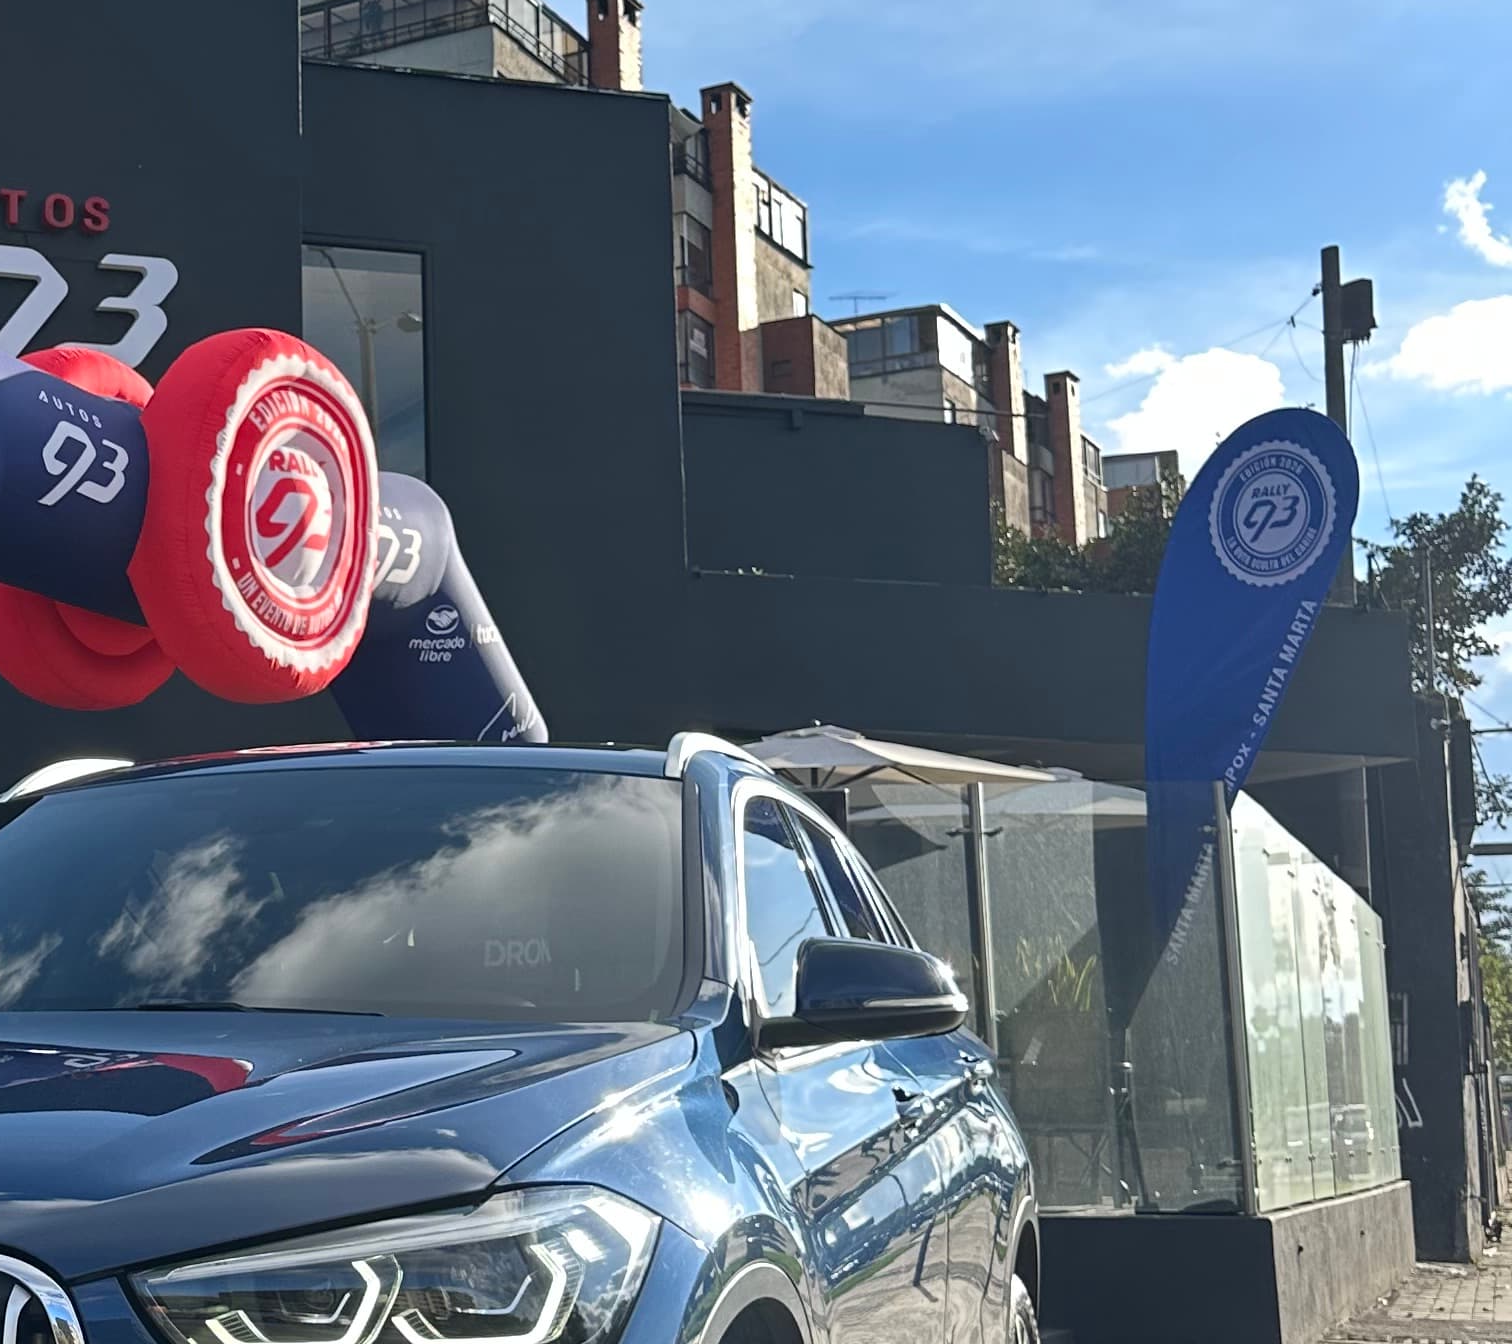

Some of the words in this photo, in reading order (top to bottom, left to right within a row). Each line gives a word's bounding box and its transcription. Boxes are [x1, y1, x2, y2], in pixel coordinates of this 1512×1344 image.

[38, 389, 103, 429] AUTOS
[37, 419, 129, 507] 93
[1251, 483, 1291, 500] RALLY
[1243, 494, 1301, 544] 93
[237, 571, 259, 600] UN
[409, 636, 465, 650] mercado
[419, 649, 452, 663] libre
[1252, 666, 1289, 727] SANTA
[1278, 599, 1318, 665] MARTA
